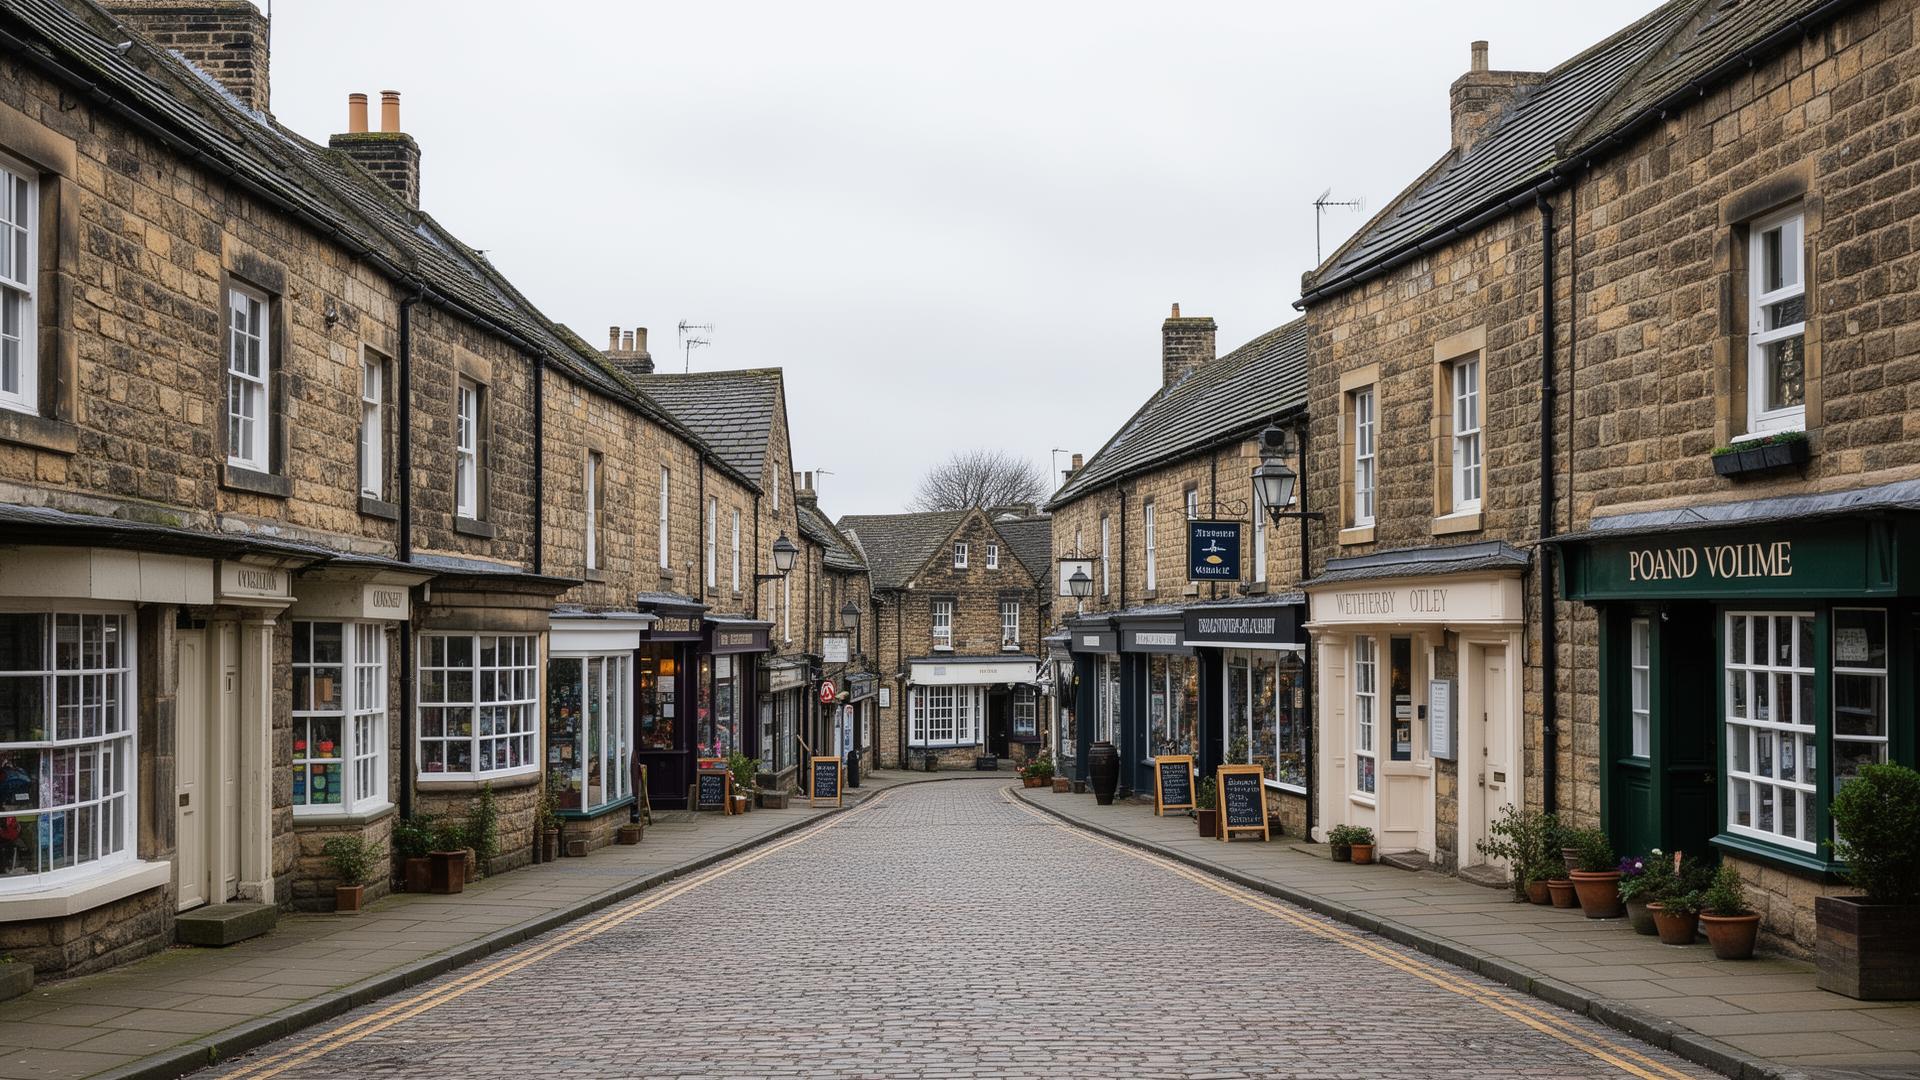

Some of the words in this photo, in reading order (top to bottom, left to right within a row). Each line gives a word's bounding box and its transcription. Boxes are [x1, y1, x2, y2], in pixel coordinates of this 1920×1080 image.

[1629, 547, 1697, 581] POAND
[1704, 541, 1793, 579] VOLIME
[1409, 589, 1448, 613] OTLEY
